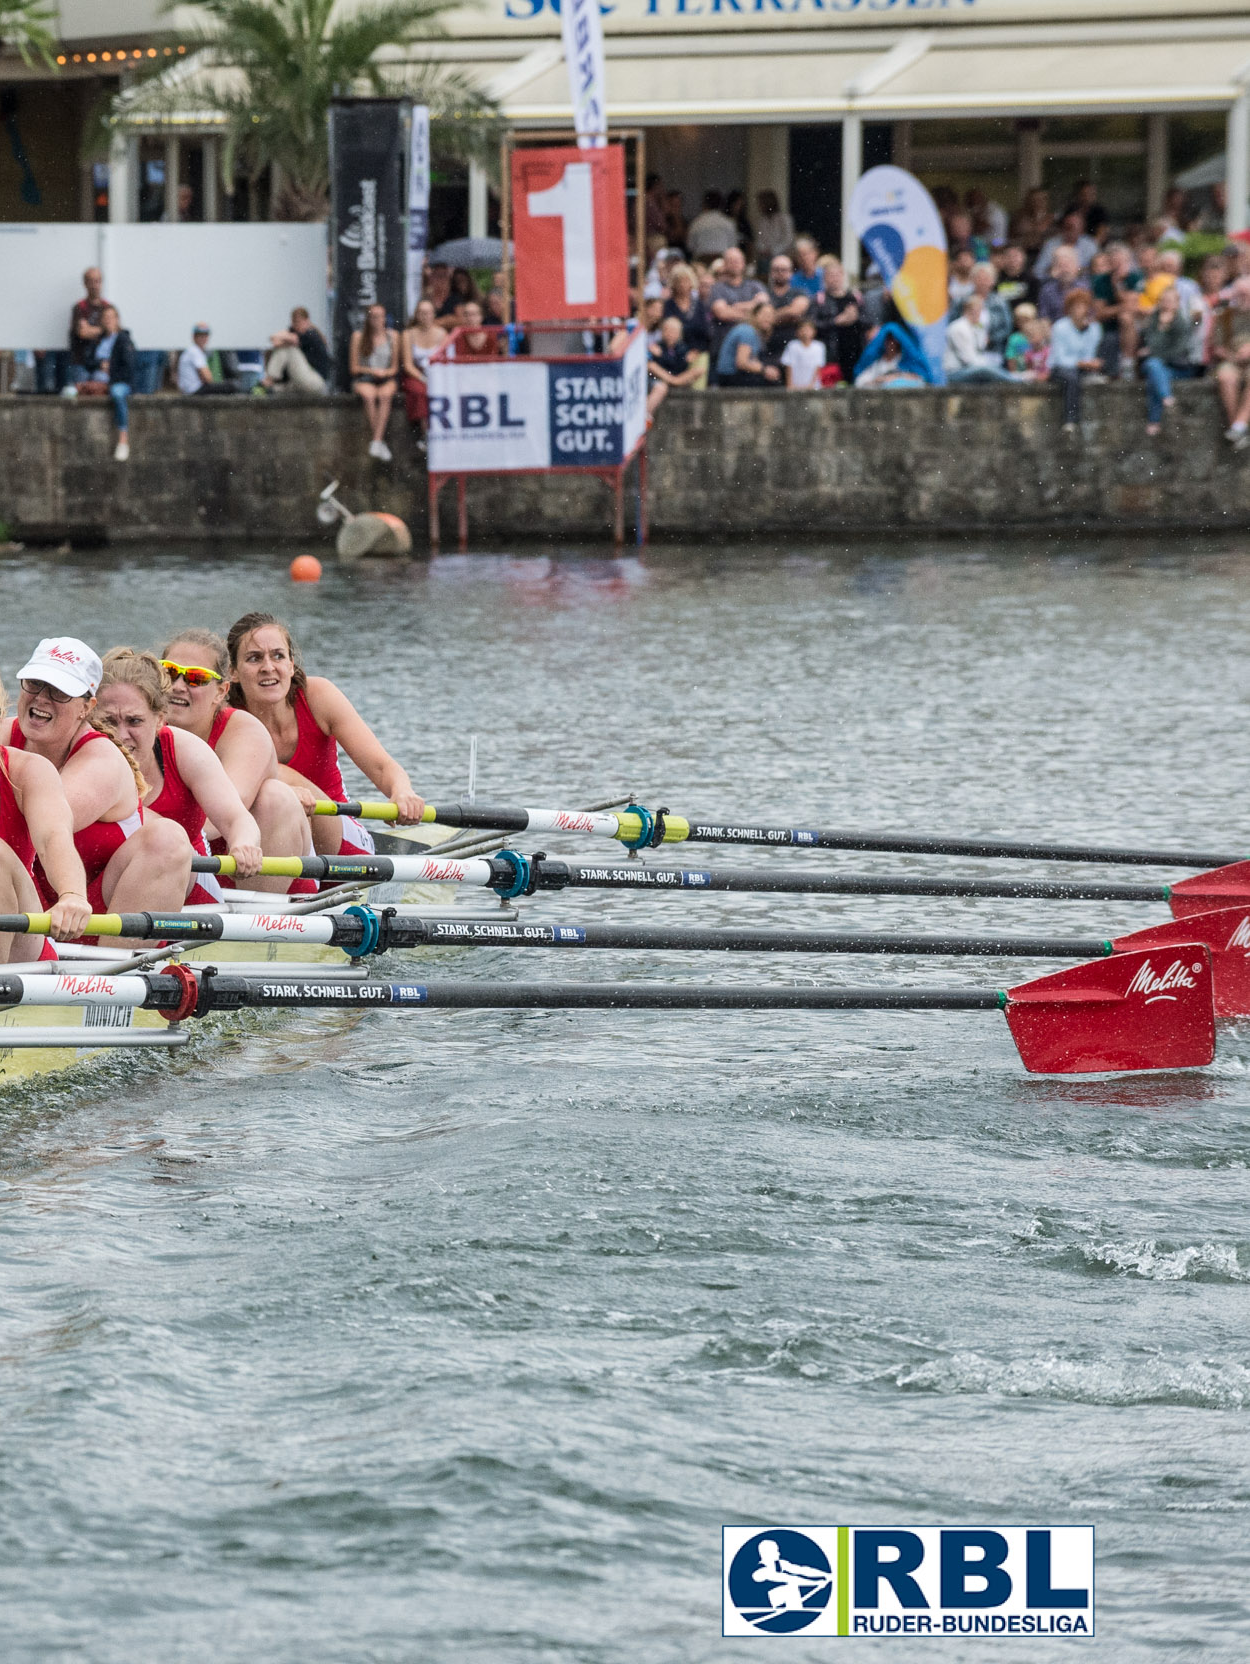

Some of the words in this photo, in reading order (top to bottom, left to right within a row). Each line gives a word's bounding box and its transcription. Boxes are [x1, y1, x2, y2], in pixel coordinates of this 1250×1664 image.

[527, 162, 597, 305] 1
[428, 394, 526, 430] RBL
[556, 429, 615, 453] GUT.
[696, 826, 725, 838] STARK.
[726, 828, 767, 840] SCHNELL.
[768, 830, 787, 841] GUT.
[797, 831, 814, 840] RBL
[580, 868, 611, 880] STARK.
[612, 869, 655, 882] SCHNELL.
[656, 872, 678, 883] GUT.
[688, 873, 705, 882] RBL
[436, 923, 473, 936] STARK.
[474, 925, 523, 938] SCHNELL.
[524, 927, 548, 939] GUT.
[559, 928, 580, 937] RBL
[263, 985, 302, 997] STARK.
[304, 985, 357, 998] SCHNELL.
[359, 987, 385, 999] GUT.
[399, 987, 420, 997] RBL
